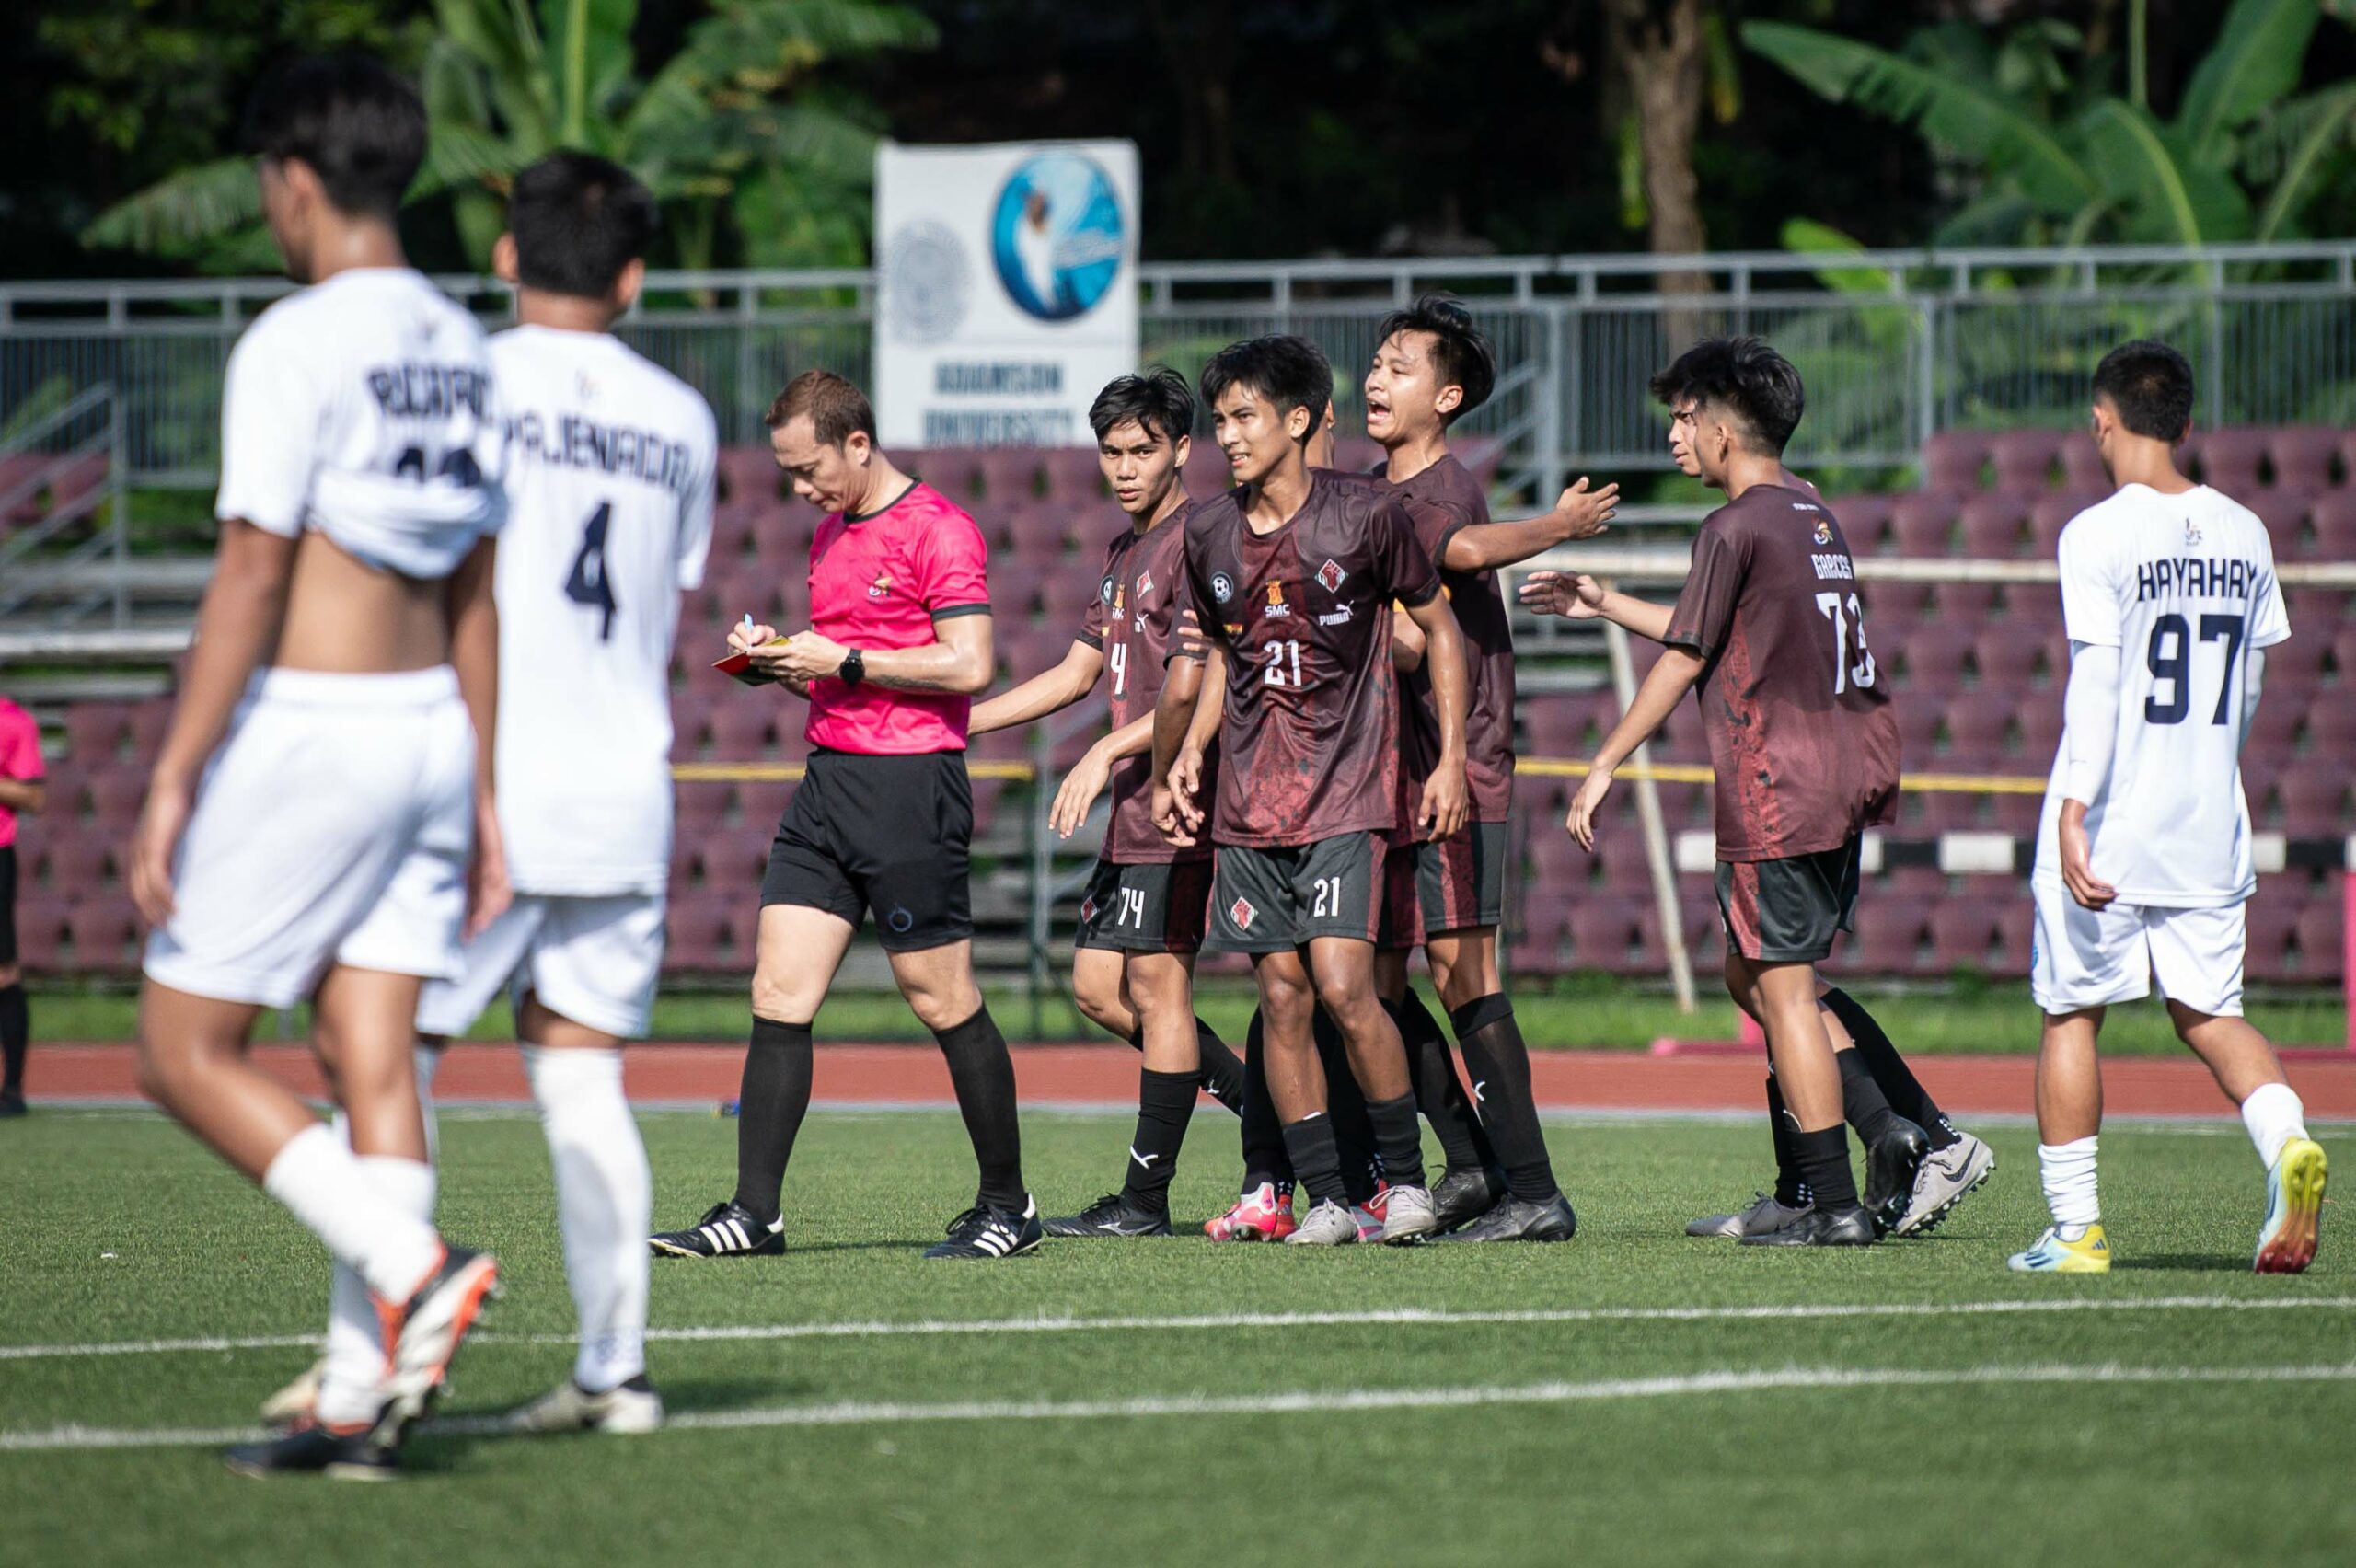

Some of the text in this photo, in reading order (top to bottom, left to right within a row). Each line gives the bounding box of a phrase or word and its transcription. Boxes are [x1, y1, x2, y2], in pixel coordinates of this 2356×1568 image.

[563, 502, 616, 641] 4
[1810, 554, 1853, 580] GARCES
[2138, 558, 2257, 602] HAYAHAY
[1265, 604, 1290, 618] SMC
[1264, 640, 1302, 686] 21
[1815, 592, 1876, 695] 73
[2145, 614, 2245, 725] 97
[1117, 886, 1146, 929] 74
[1313, 876, 1340, 917] 21
